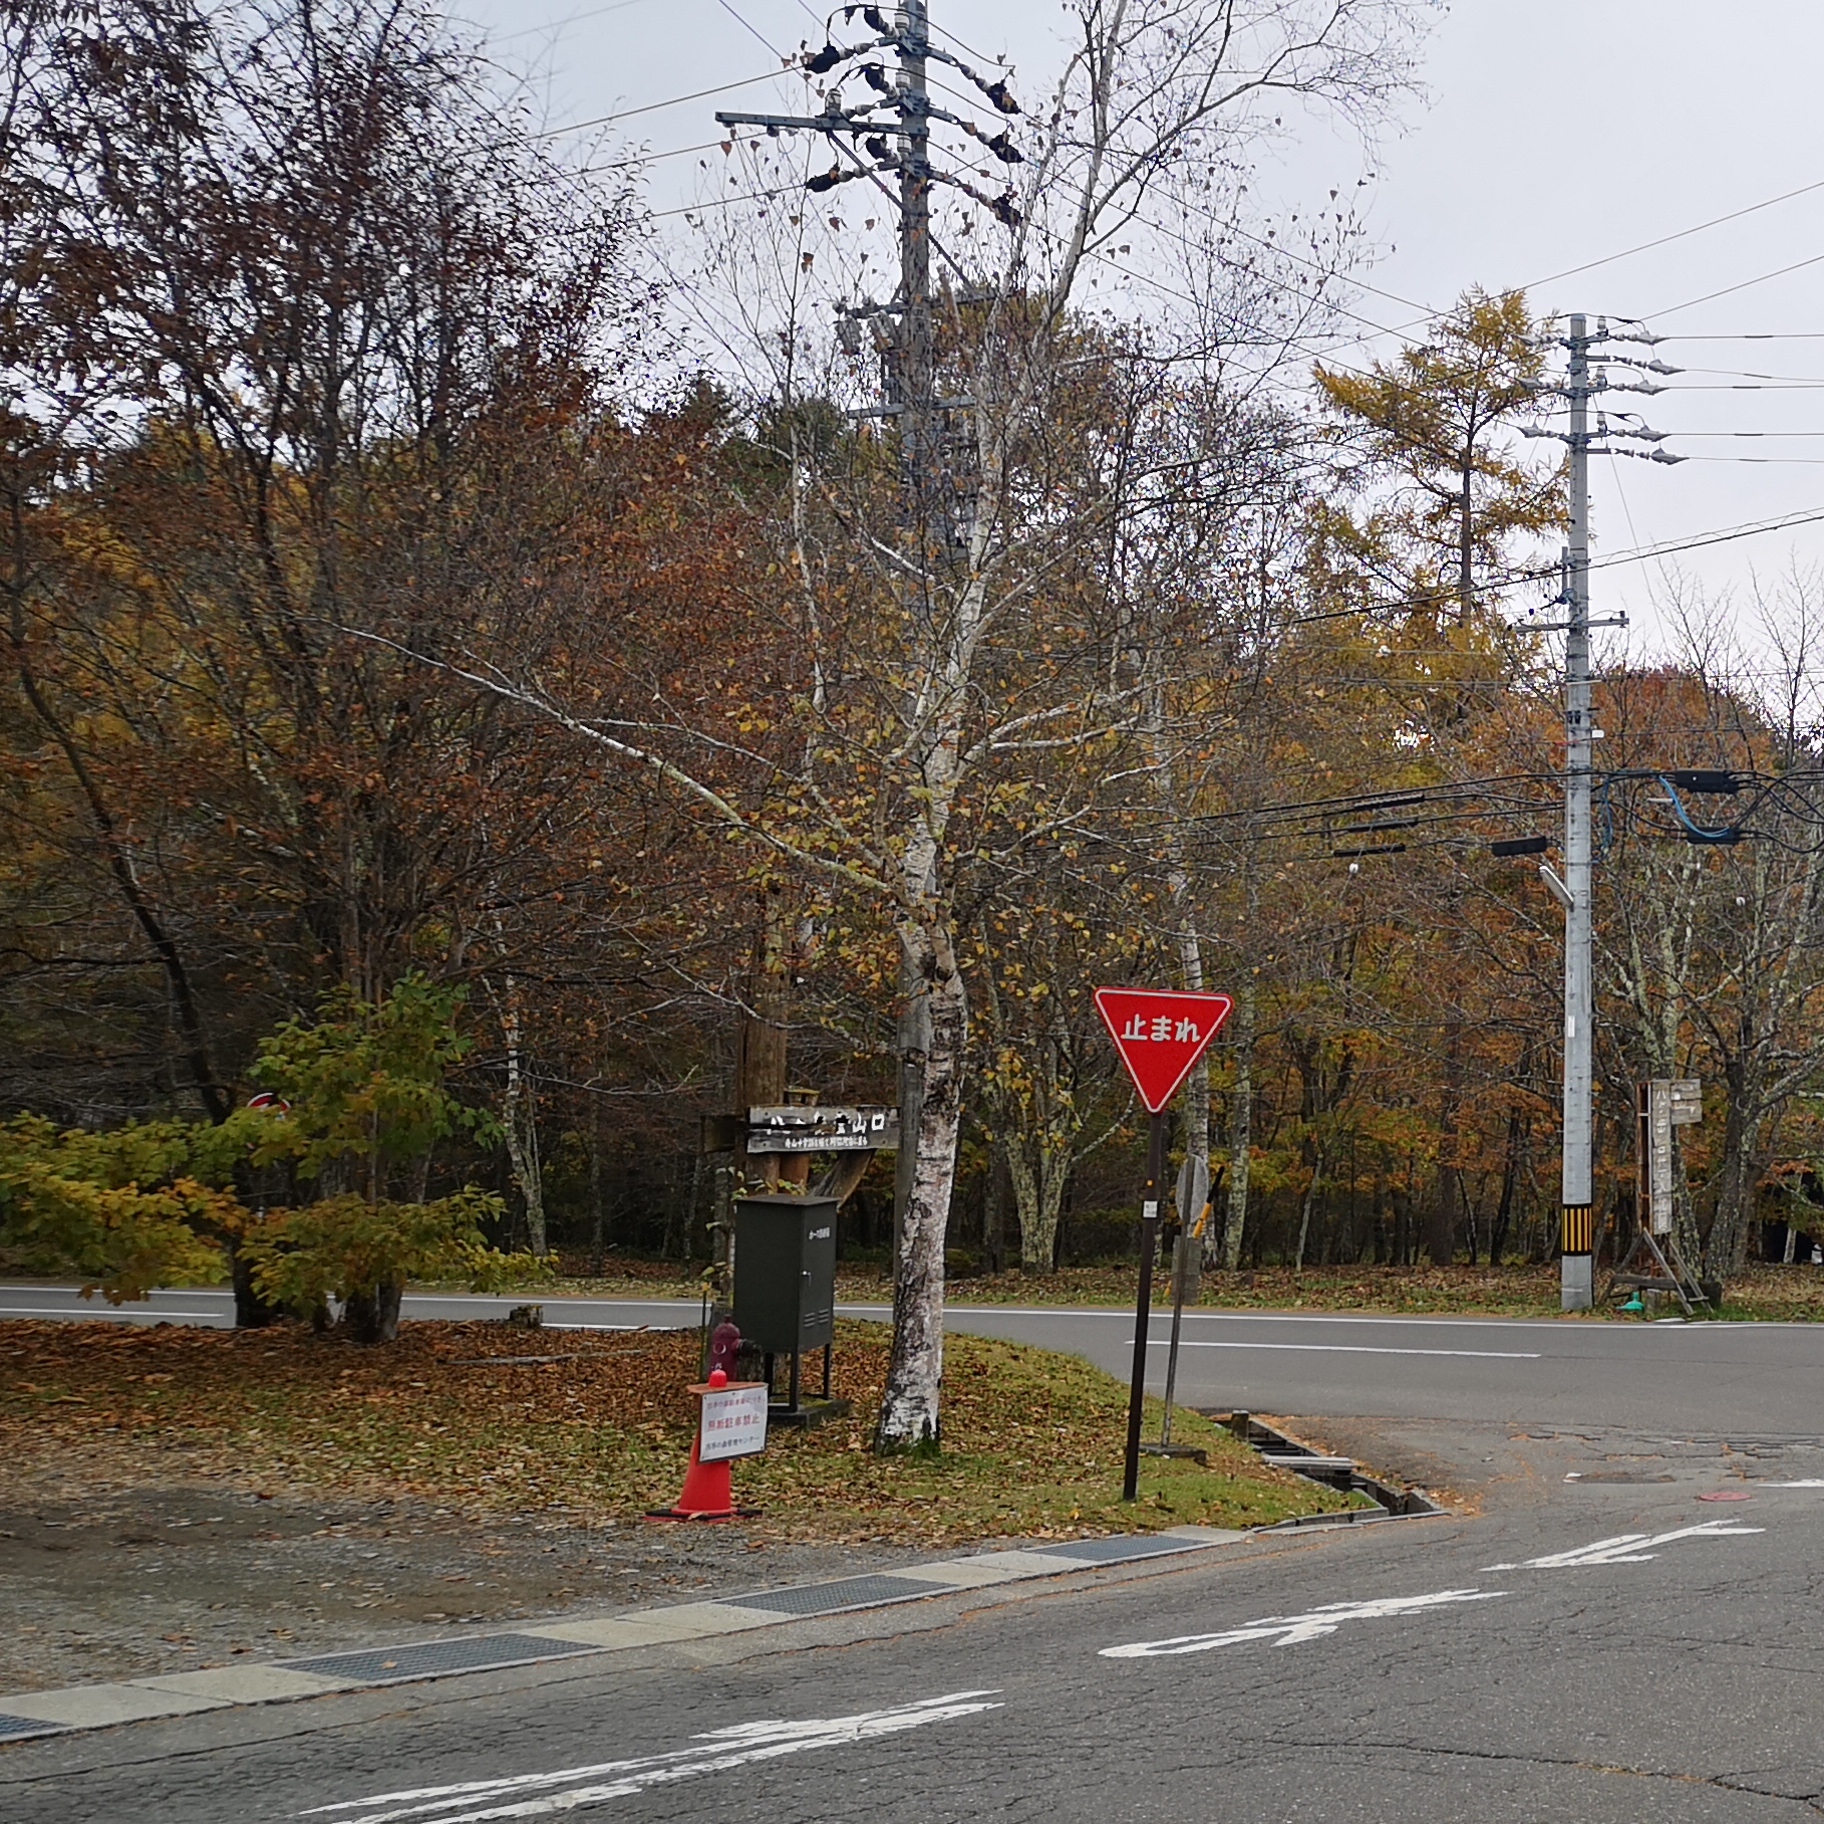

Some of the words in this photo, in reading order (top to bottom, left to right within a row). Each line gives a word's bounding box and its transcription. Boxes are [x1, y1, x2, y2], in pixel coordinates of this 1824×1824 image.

[1121, 1014, 1201, 1043] 止まれ
[707, 1413, 761, 1432] 無断駐車禁止
